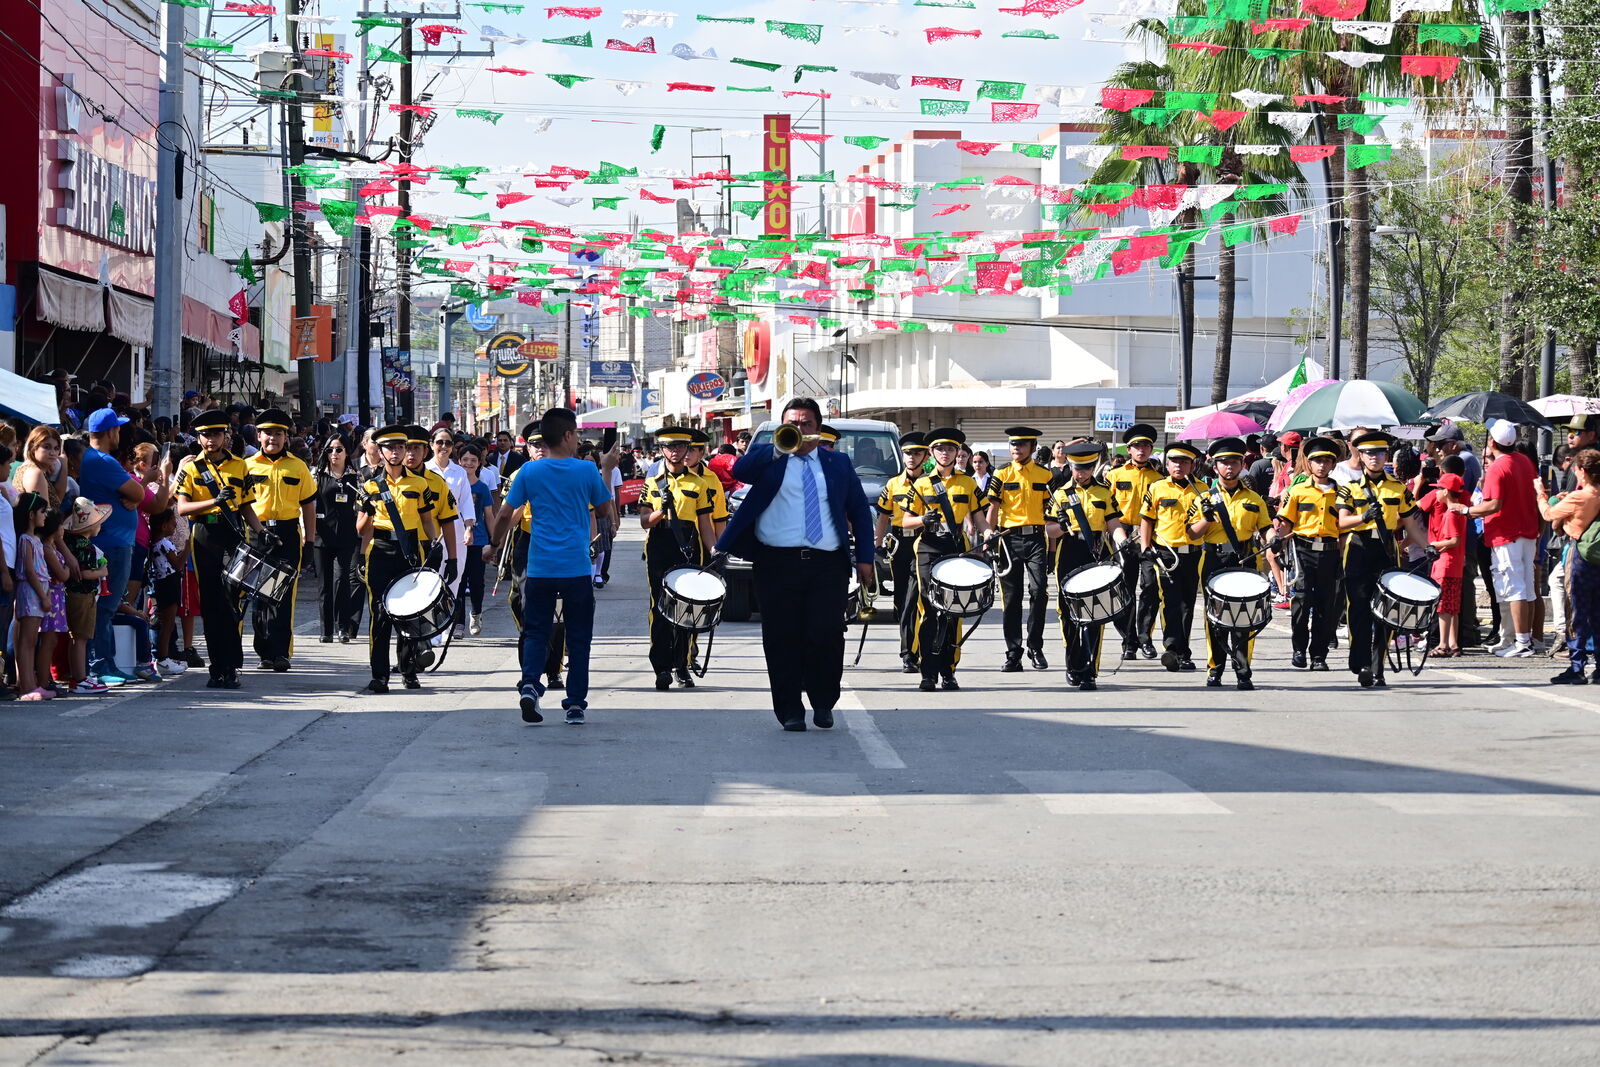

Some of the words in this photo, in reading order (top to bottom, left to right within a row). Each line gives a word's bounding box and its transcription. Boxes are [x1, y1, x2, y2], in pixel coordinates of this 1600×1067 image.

[688, 377, 725, 394] VIAJEROS
[1099, 413, 1123, 421] WIFI
[1097, 421, 1134, 430] GRATIS
